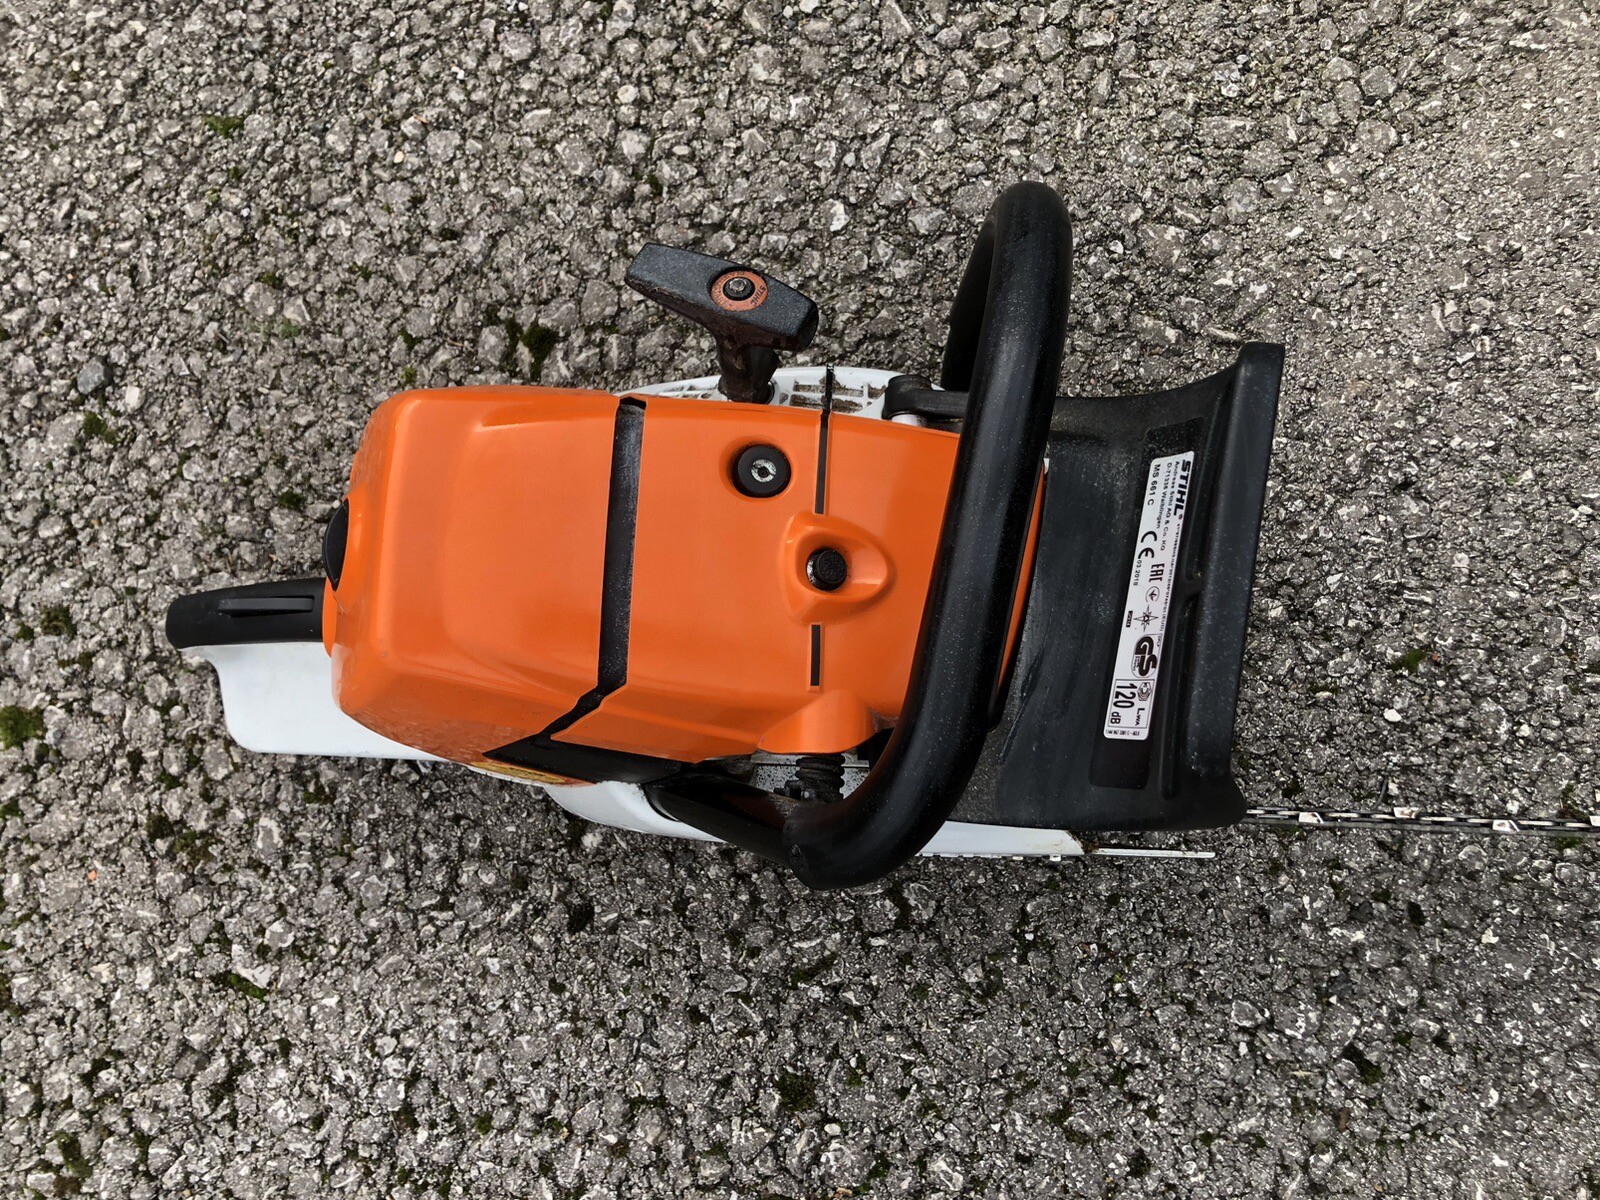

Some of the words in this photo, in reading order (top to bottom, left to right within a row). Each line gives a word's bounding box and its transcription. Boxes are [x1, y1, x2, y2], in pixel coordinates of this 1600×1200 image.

[750, 285, 766, 304] STIHL
[1152, 463, 1161, 478] MS
[1171, 461, 1180, 489] Andreas
[1149, 481, 1158, 496] 661
[1147, 498, 1155, 506] C
[1167, 491, 1175, 506] Stihl
[1156, 491, 1167, 529] Waiblingen
[1166, 507, 1172, 518] AG
[1160, 540, 1167, 551] KG
[1135, 636, 1158, 676] GS
[1113, 683, 1138, 709] 120
[1110, 711, 1121, 725] dB
